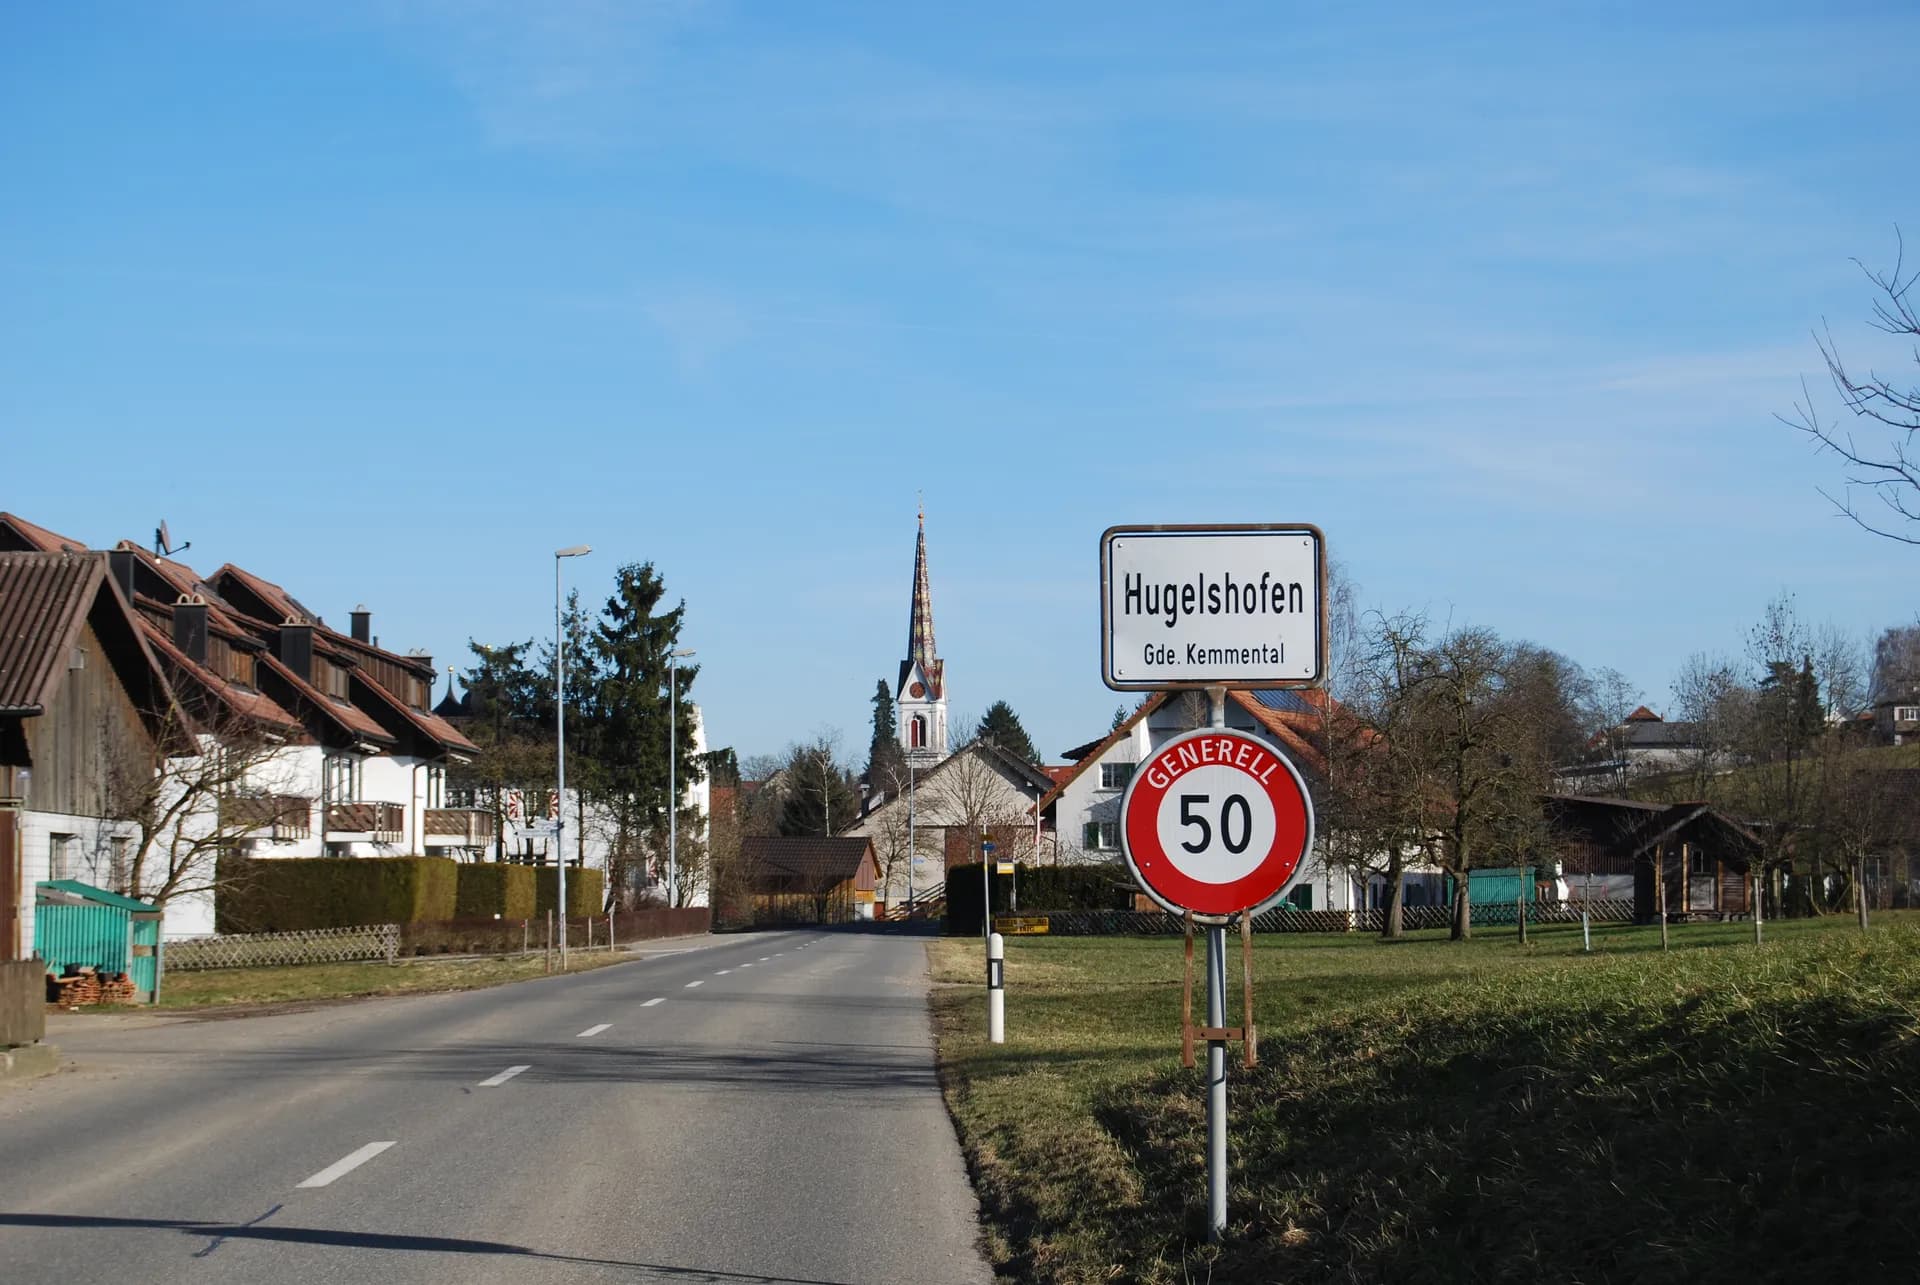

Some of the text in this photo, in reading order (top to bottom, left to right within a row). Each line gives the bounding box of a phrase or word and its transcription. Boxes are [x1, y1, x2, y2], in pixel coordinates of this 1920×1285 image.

[1125, 571, 1303, 628] Hugelshofen
[1144, 643, 1284, 665] Gde. Kemmental
[1147, 739, 1278, 789] GENERELL
[1180, 793, 1253, 855] 50
